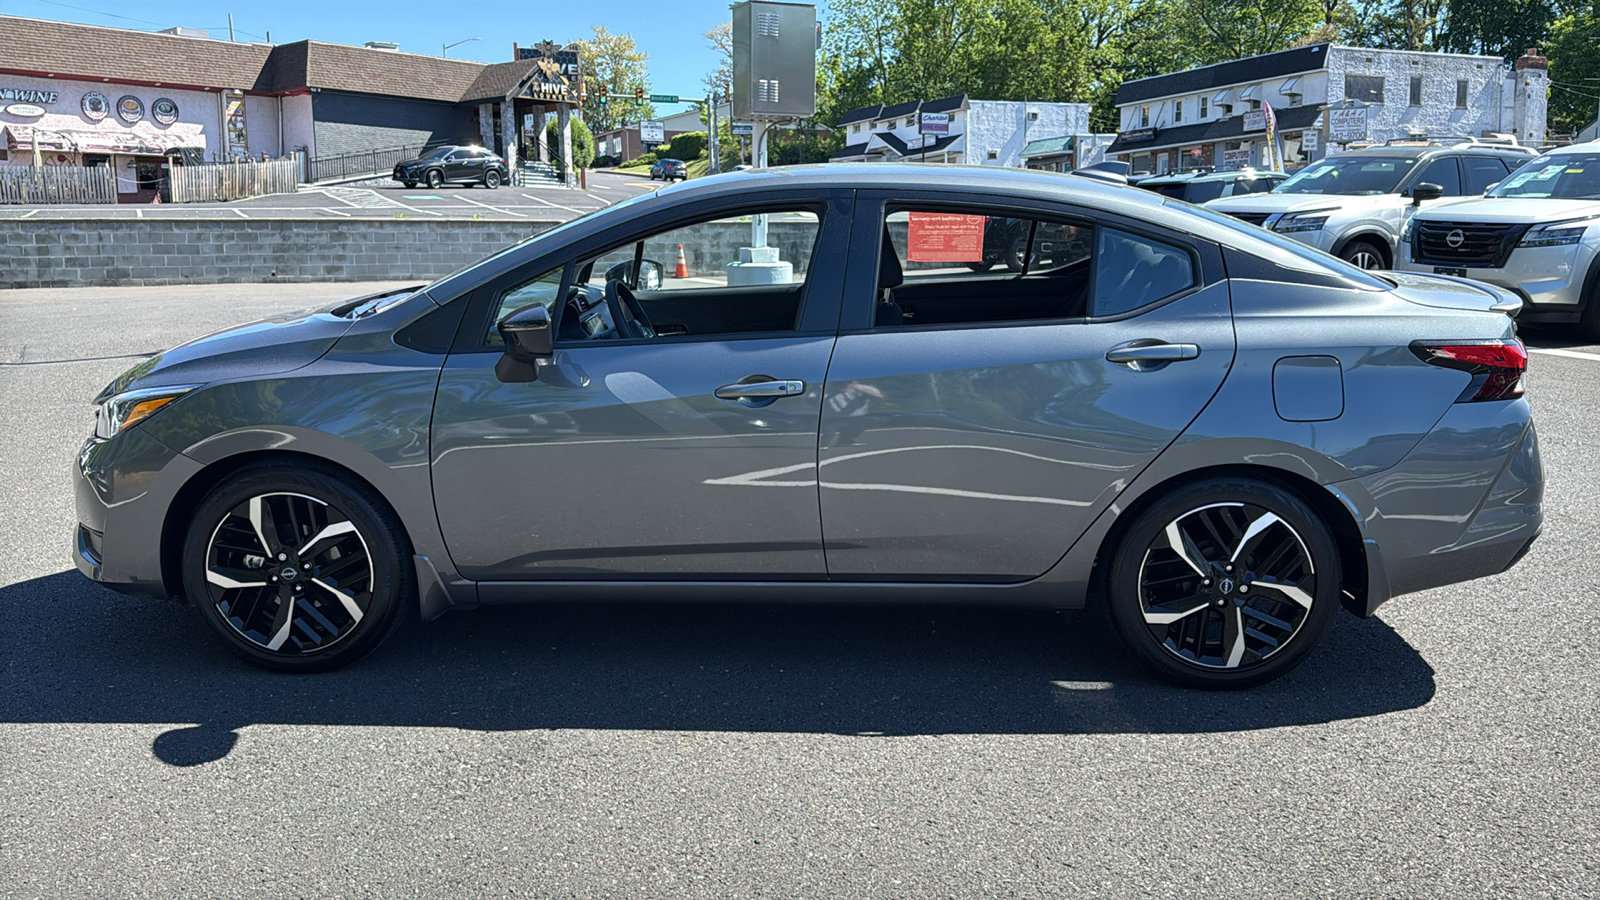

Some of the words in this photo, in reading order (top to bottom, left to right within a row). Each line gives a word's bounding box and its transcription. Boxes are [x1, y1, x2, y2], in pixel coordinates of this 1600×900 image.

[541, 83, 568, 95] HIVE
[14, 89, 58, 104] WINE
[1331, 117, 1364, 125] COMPUTERS
[1330, 131, 1366, 140] 942-9700
